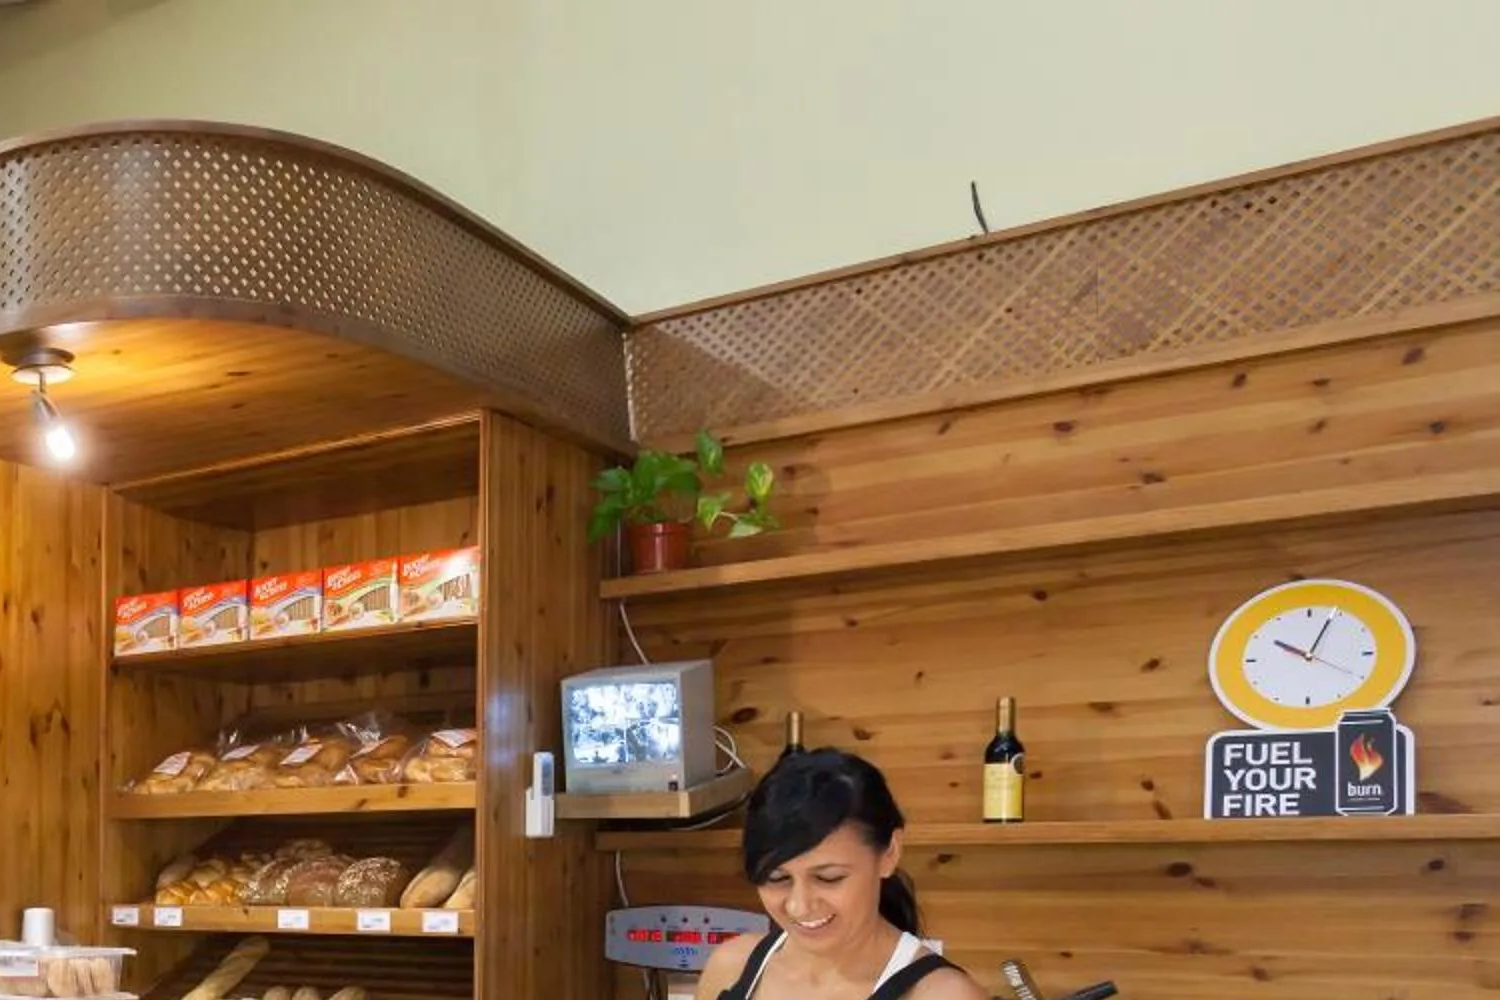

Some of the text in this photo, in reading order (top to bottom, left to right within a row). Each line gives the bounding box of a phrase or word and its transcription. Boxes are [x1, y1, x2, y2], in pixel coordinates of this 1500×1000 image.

[1223, 742, 1313, 767] FUEL
[1223, 767, 1317, 791] YOUR
[1347, 782, 1381, 797] burn
[1222, 793, 1301, 816] FIRE
